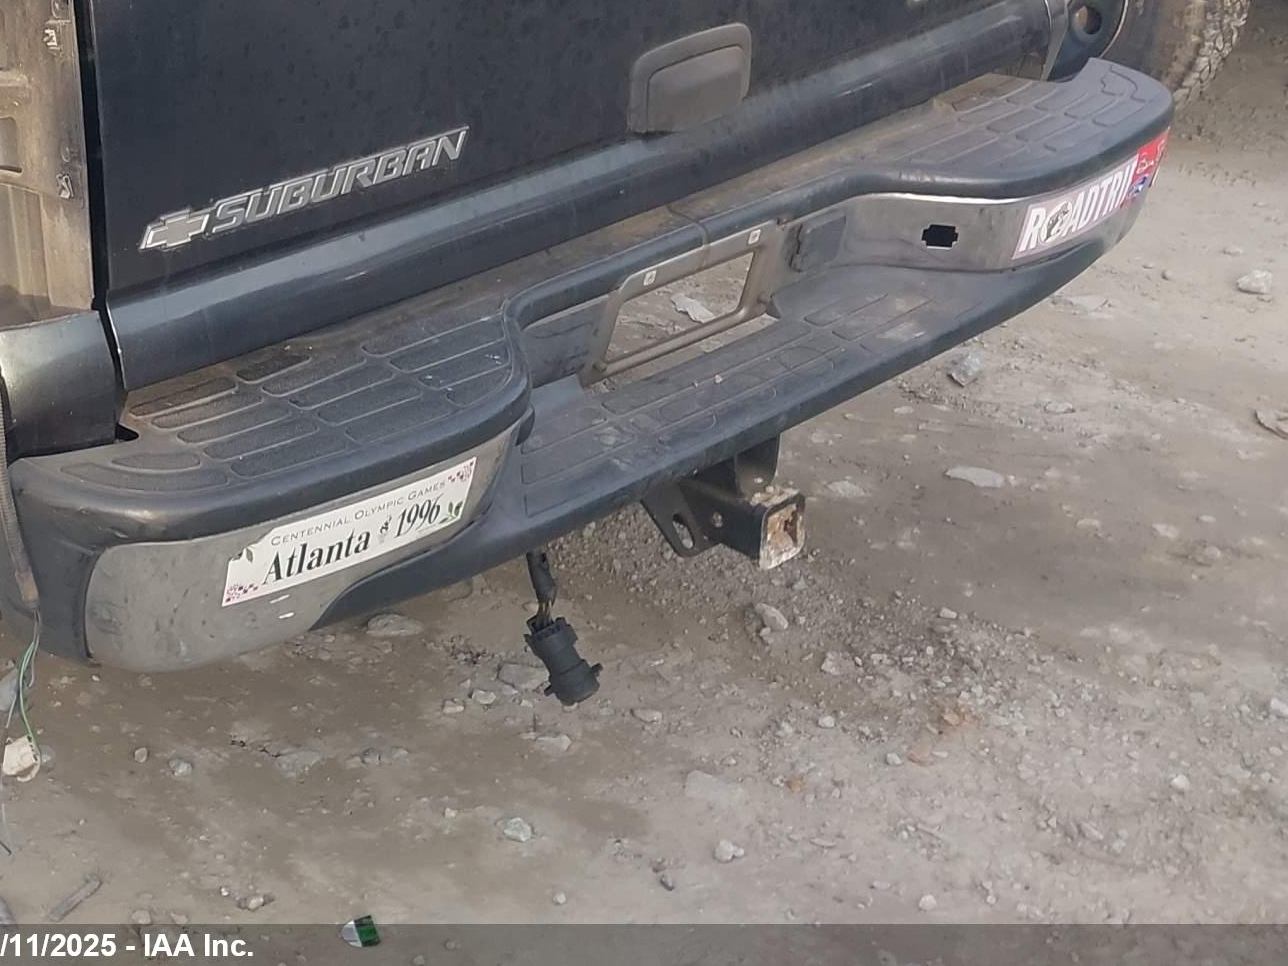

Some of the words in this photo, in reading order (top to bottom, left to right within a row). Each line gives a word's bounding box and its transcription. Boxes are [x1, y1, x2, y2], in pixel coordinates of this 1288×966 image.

[211, 126, 470, 234] SUBURBAN
[262, 529, 372, 586] Atlanta
[395, 493, 445, 539] 1996
[270, 518, 351, 547] CENTENNIAL
[353, 498, 405, 521] OLYMPIC
[407, 481, 446, 502] GAMES
